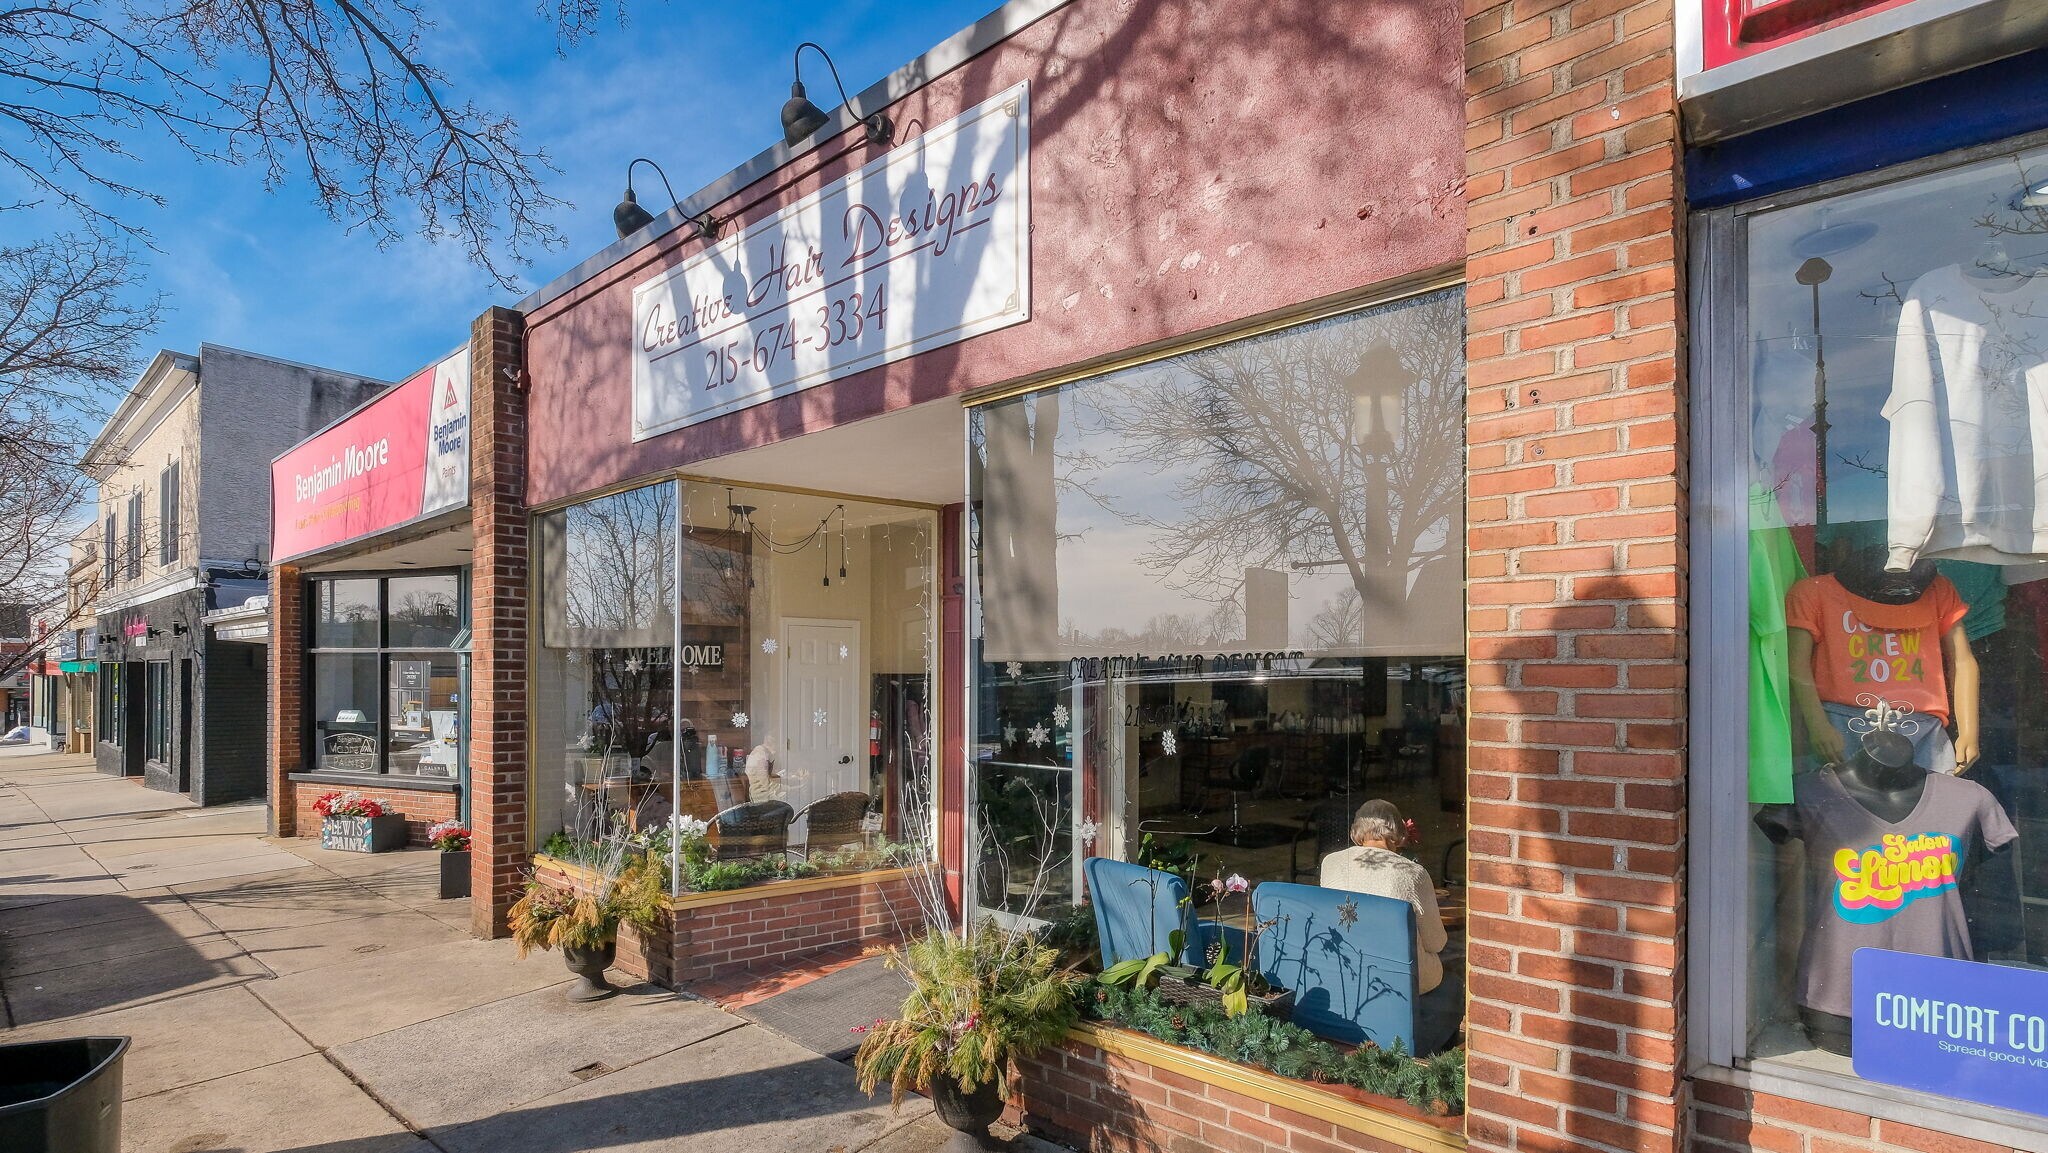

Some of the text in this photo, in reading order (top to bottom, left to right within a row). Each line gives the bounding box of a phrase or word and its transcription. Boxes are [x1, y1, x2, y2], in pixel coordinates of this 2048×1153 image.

[642, 171, 1003, 353] Creative Hair Designs
[704, 282, 888, 391] 215-674-3334
[434, 412, 466, 441] Benjamin
[438, 436, 461, 457] Moore
[295, 438, 388, 503] Benjamin Moore
[1848, 632, 1920, 658] CREW
[1067, 654, 1150, 681] CREATIVE
[1850, 657, 1924, 683] 2024
[331, 820, 363, 836] LEWIS
[331, 835, 364, 851] PAINT
[1882, 833, 1949, 862] Salon
[1833, 848, 1958, 902] Limon
[1875, 992, 2000, 1045] COMFORT
[1938, 1040, 1986, 1058] Spread
[1988, 1050, 2025, 1066] good
